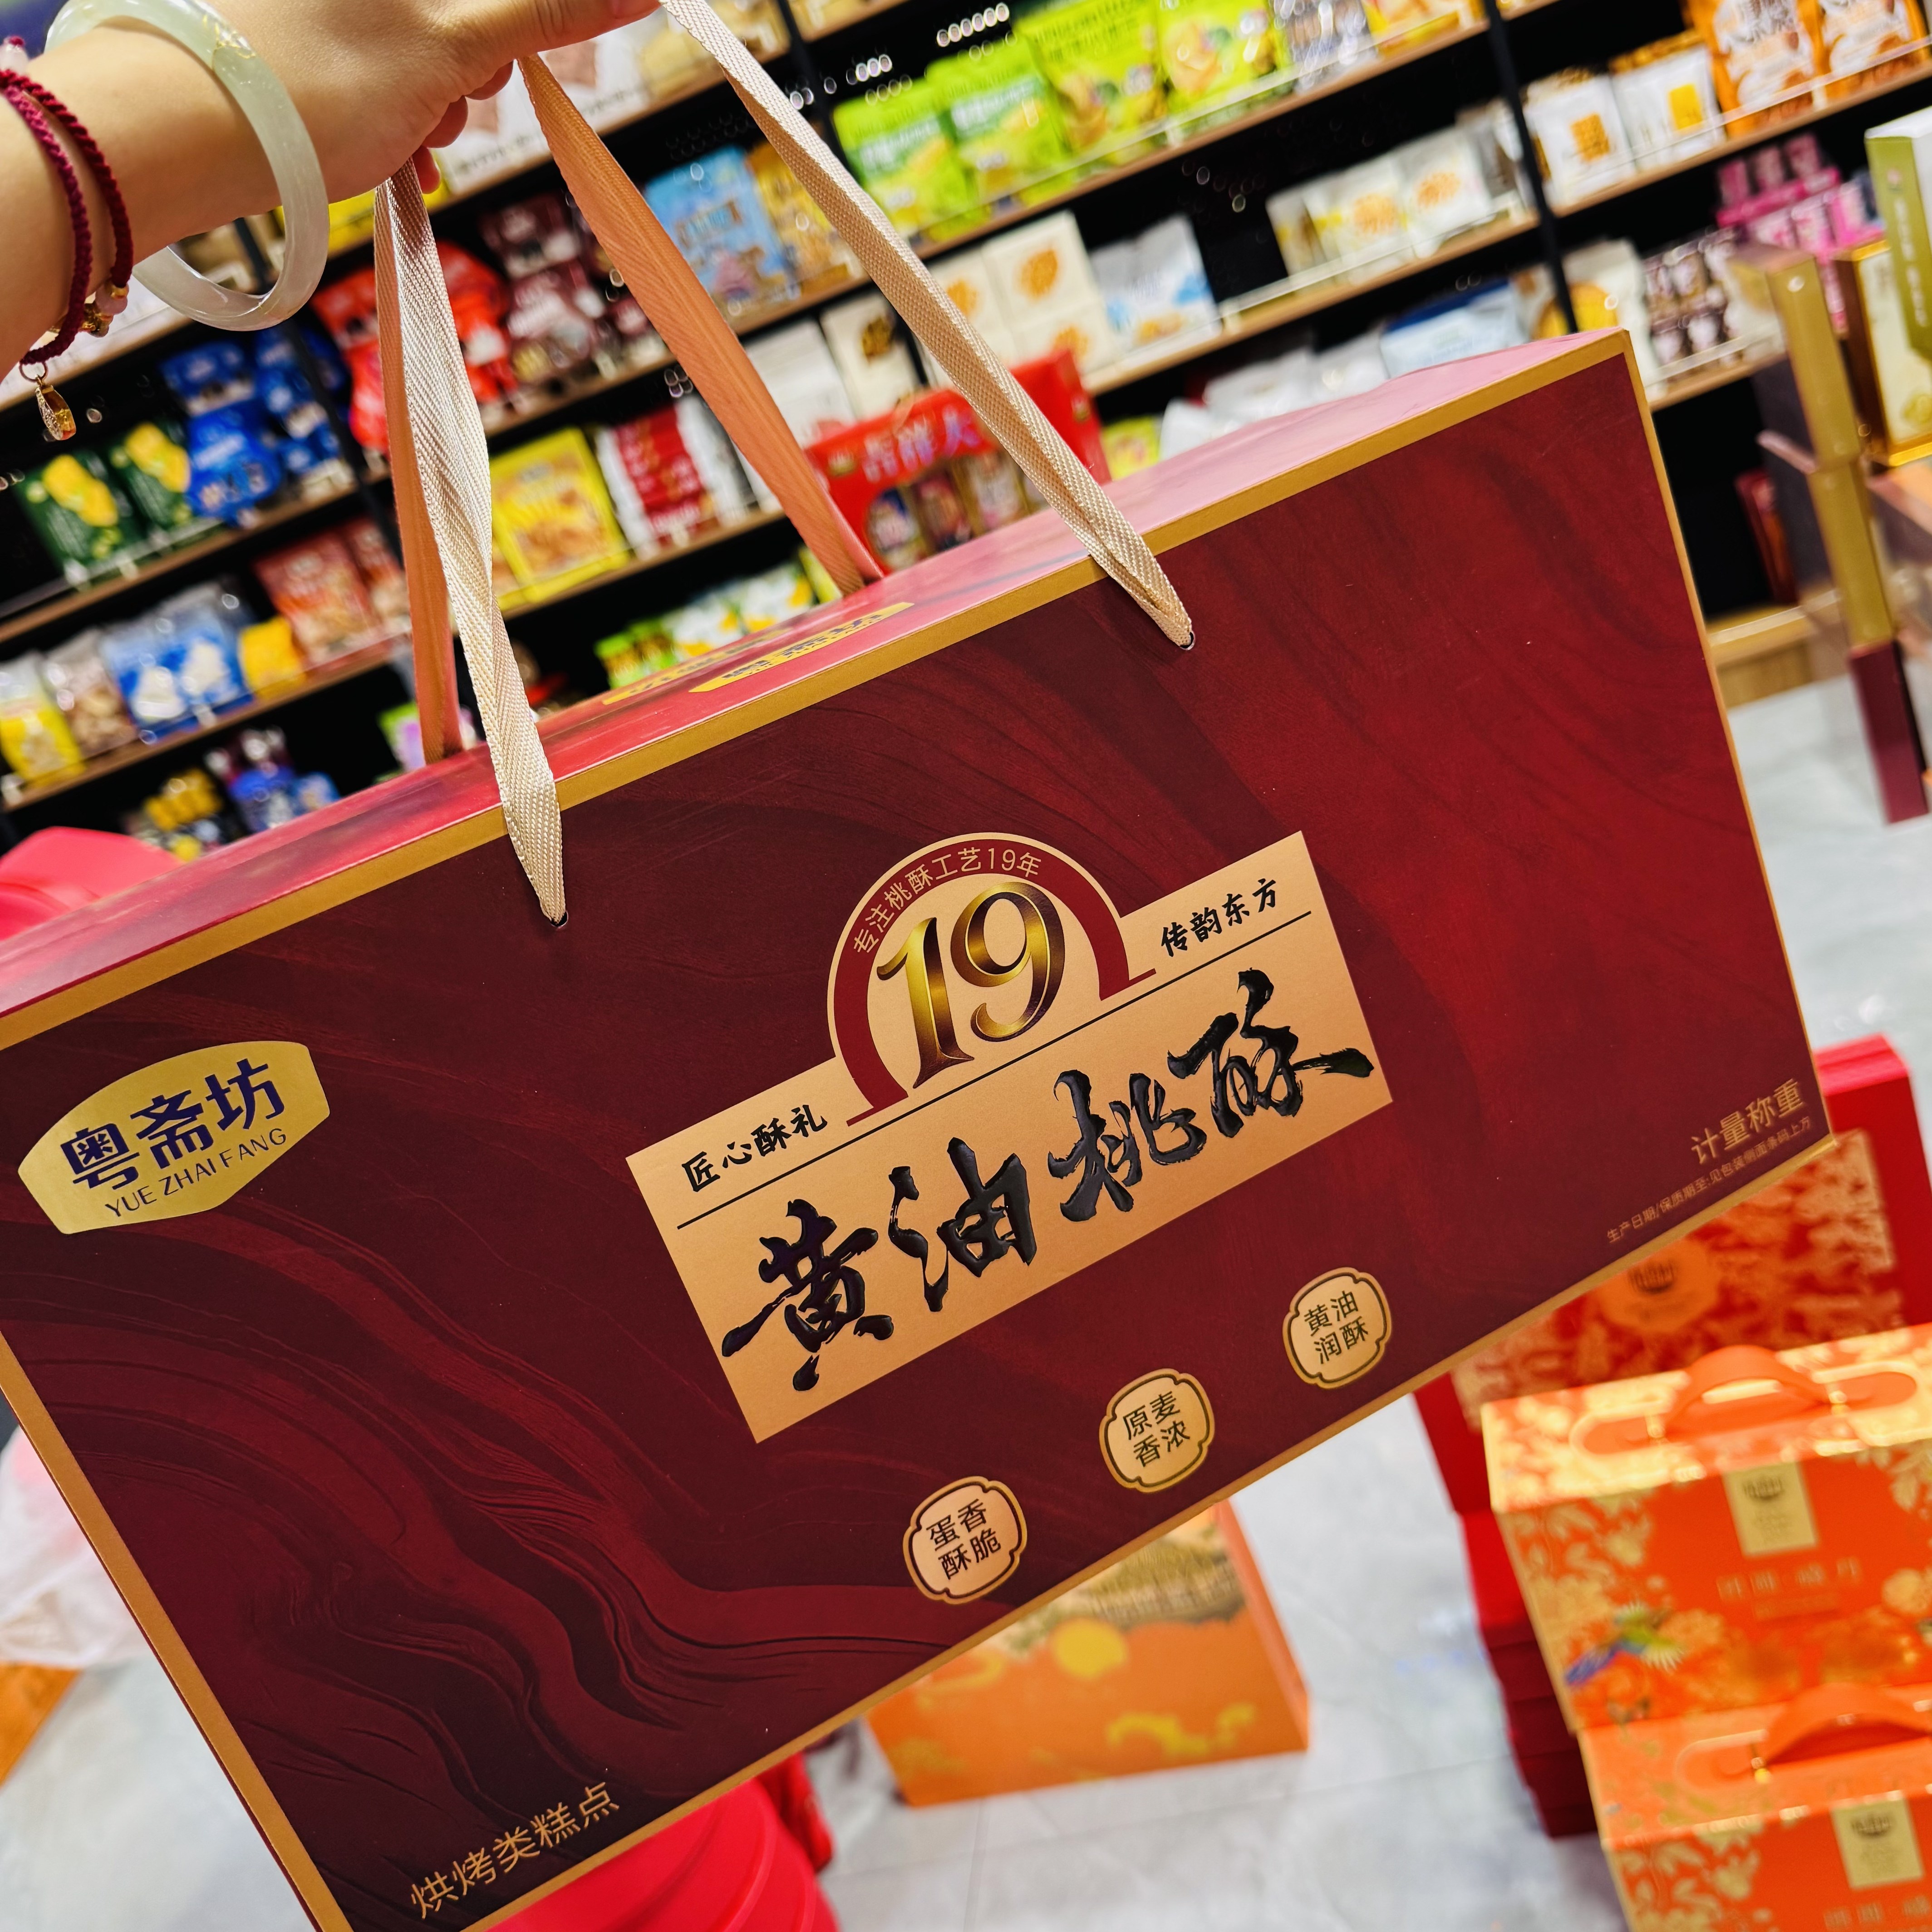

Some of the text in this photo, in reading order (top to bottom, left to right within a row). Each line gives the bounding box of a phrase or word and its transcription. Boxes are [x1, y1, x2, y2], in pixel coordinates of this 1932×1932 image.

[853, 847, 1042, 953] 专注桃酥工艺19年
[1161, 878, 1276, 957] 传韵东方
[876, 881, 1065, 1088] 19
[60, 1058, 285, 1190] 粤斋坊
[681, 1105, 828, 1192] 匠心酥礼
[1691, 1078, 1804, 1165] 计量称重
[105, 1128, 287, 1218] YUE ZHAI FANG
[721, 968, 1374, 1391] 黄油桃酥
[1304, 1290, 1358, 1337] 黄油
[1314, 1316, 1368, 1364] 润酥
[1123, 1391, 1180, 1440] 原麦
[1133, 1420, 1190, 1467] 香浓
[926, 1499, 986, 1551] 蛋香
[938, 1528, 1001, 1580] 酥脆
[411, 1782, 619, 1919] 烘烤类糕点
